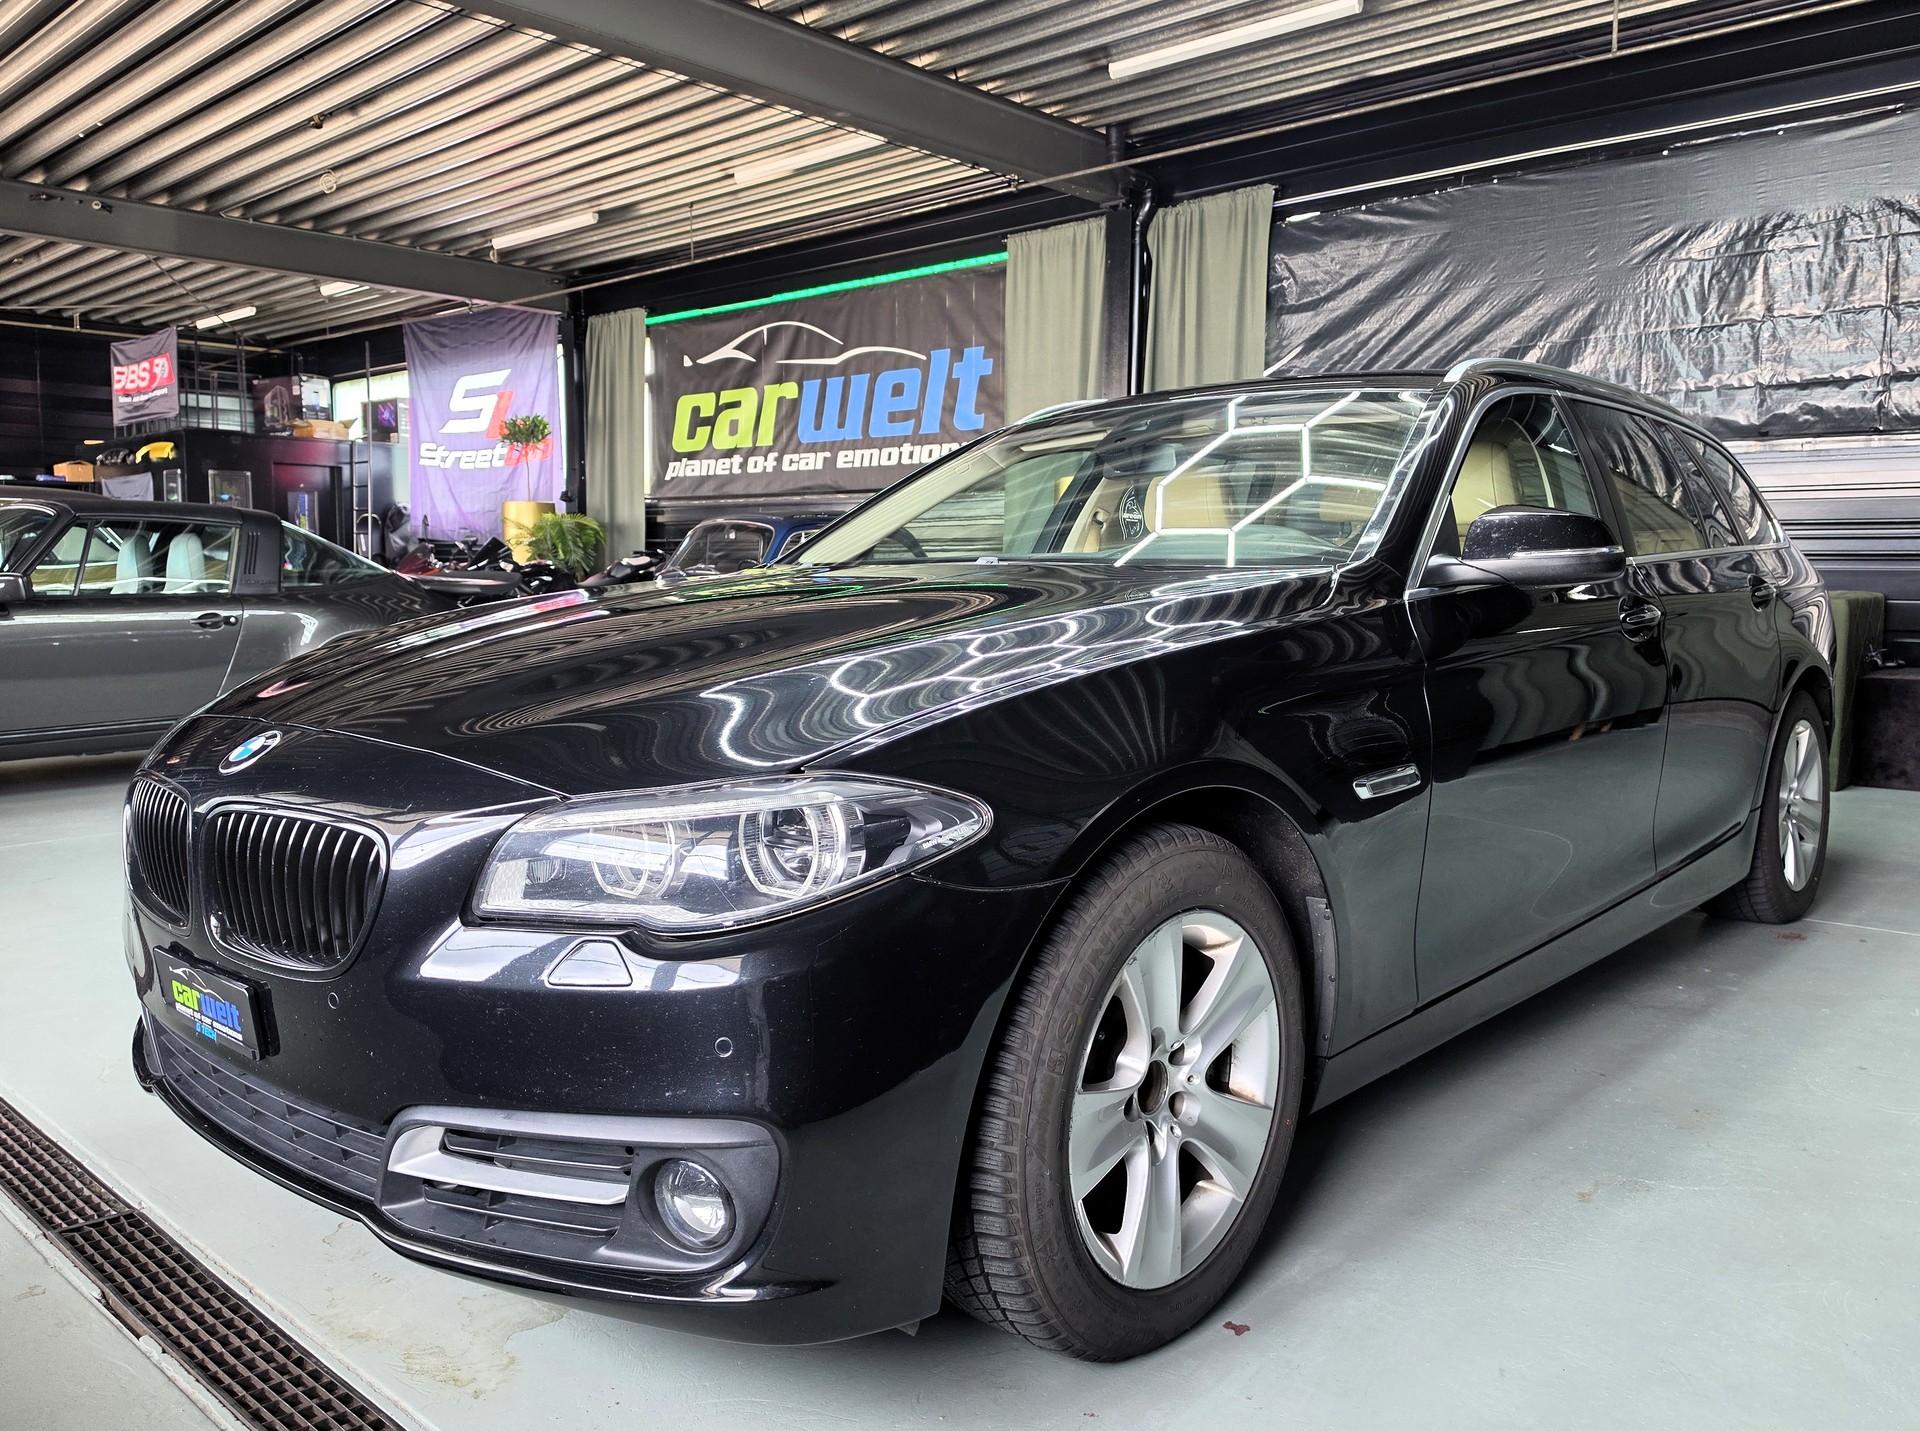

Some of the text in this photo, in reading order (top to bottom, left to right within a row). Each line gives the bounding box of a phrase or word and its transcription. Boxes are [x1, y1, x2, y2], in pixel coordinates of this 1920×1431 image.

[113, 360, 151, 391] BBS
[672, 345, 994, 453] carwelt
[665, 457, 743, 481] planet
[746, 452, 778, 473] of
[781, 450, 832, 472] car
[922, 839, 938, 850] BMW
[1055, 876, 1153, 1044] SUNNY
[171, 979, 242, 1032] carwelt
